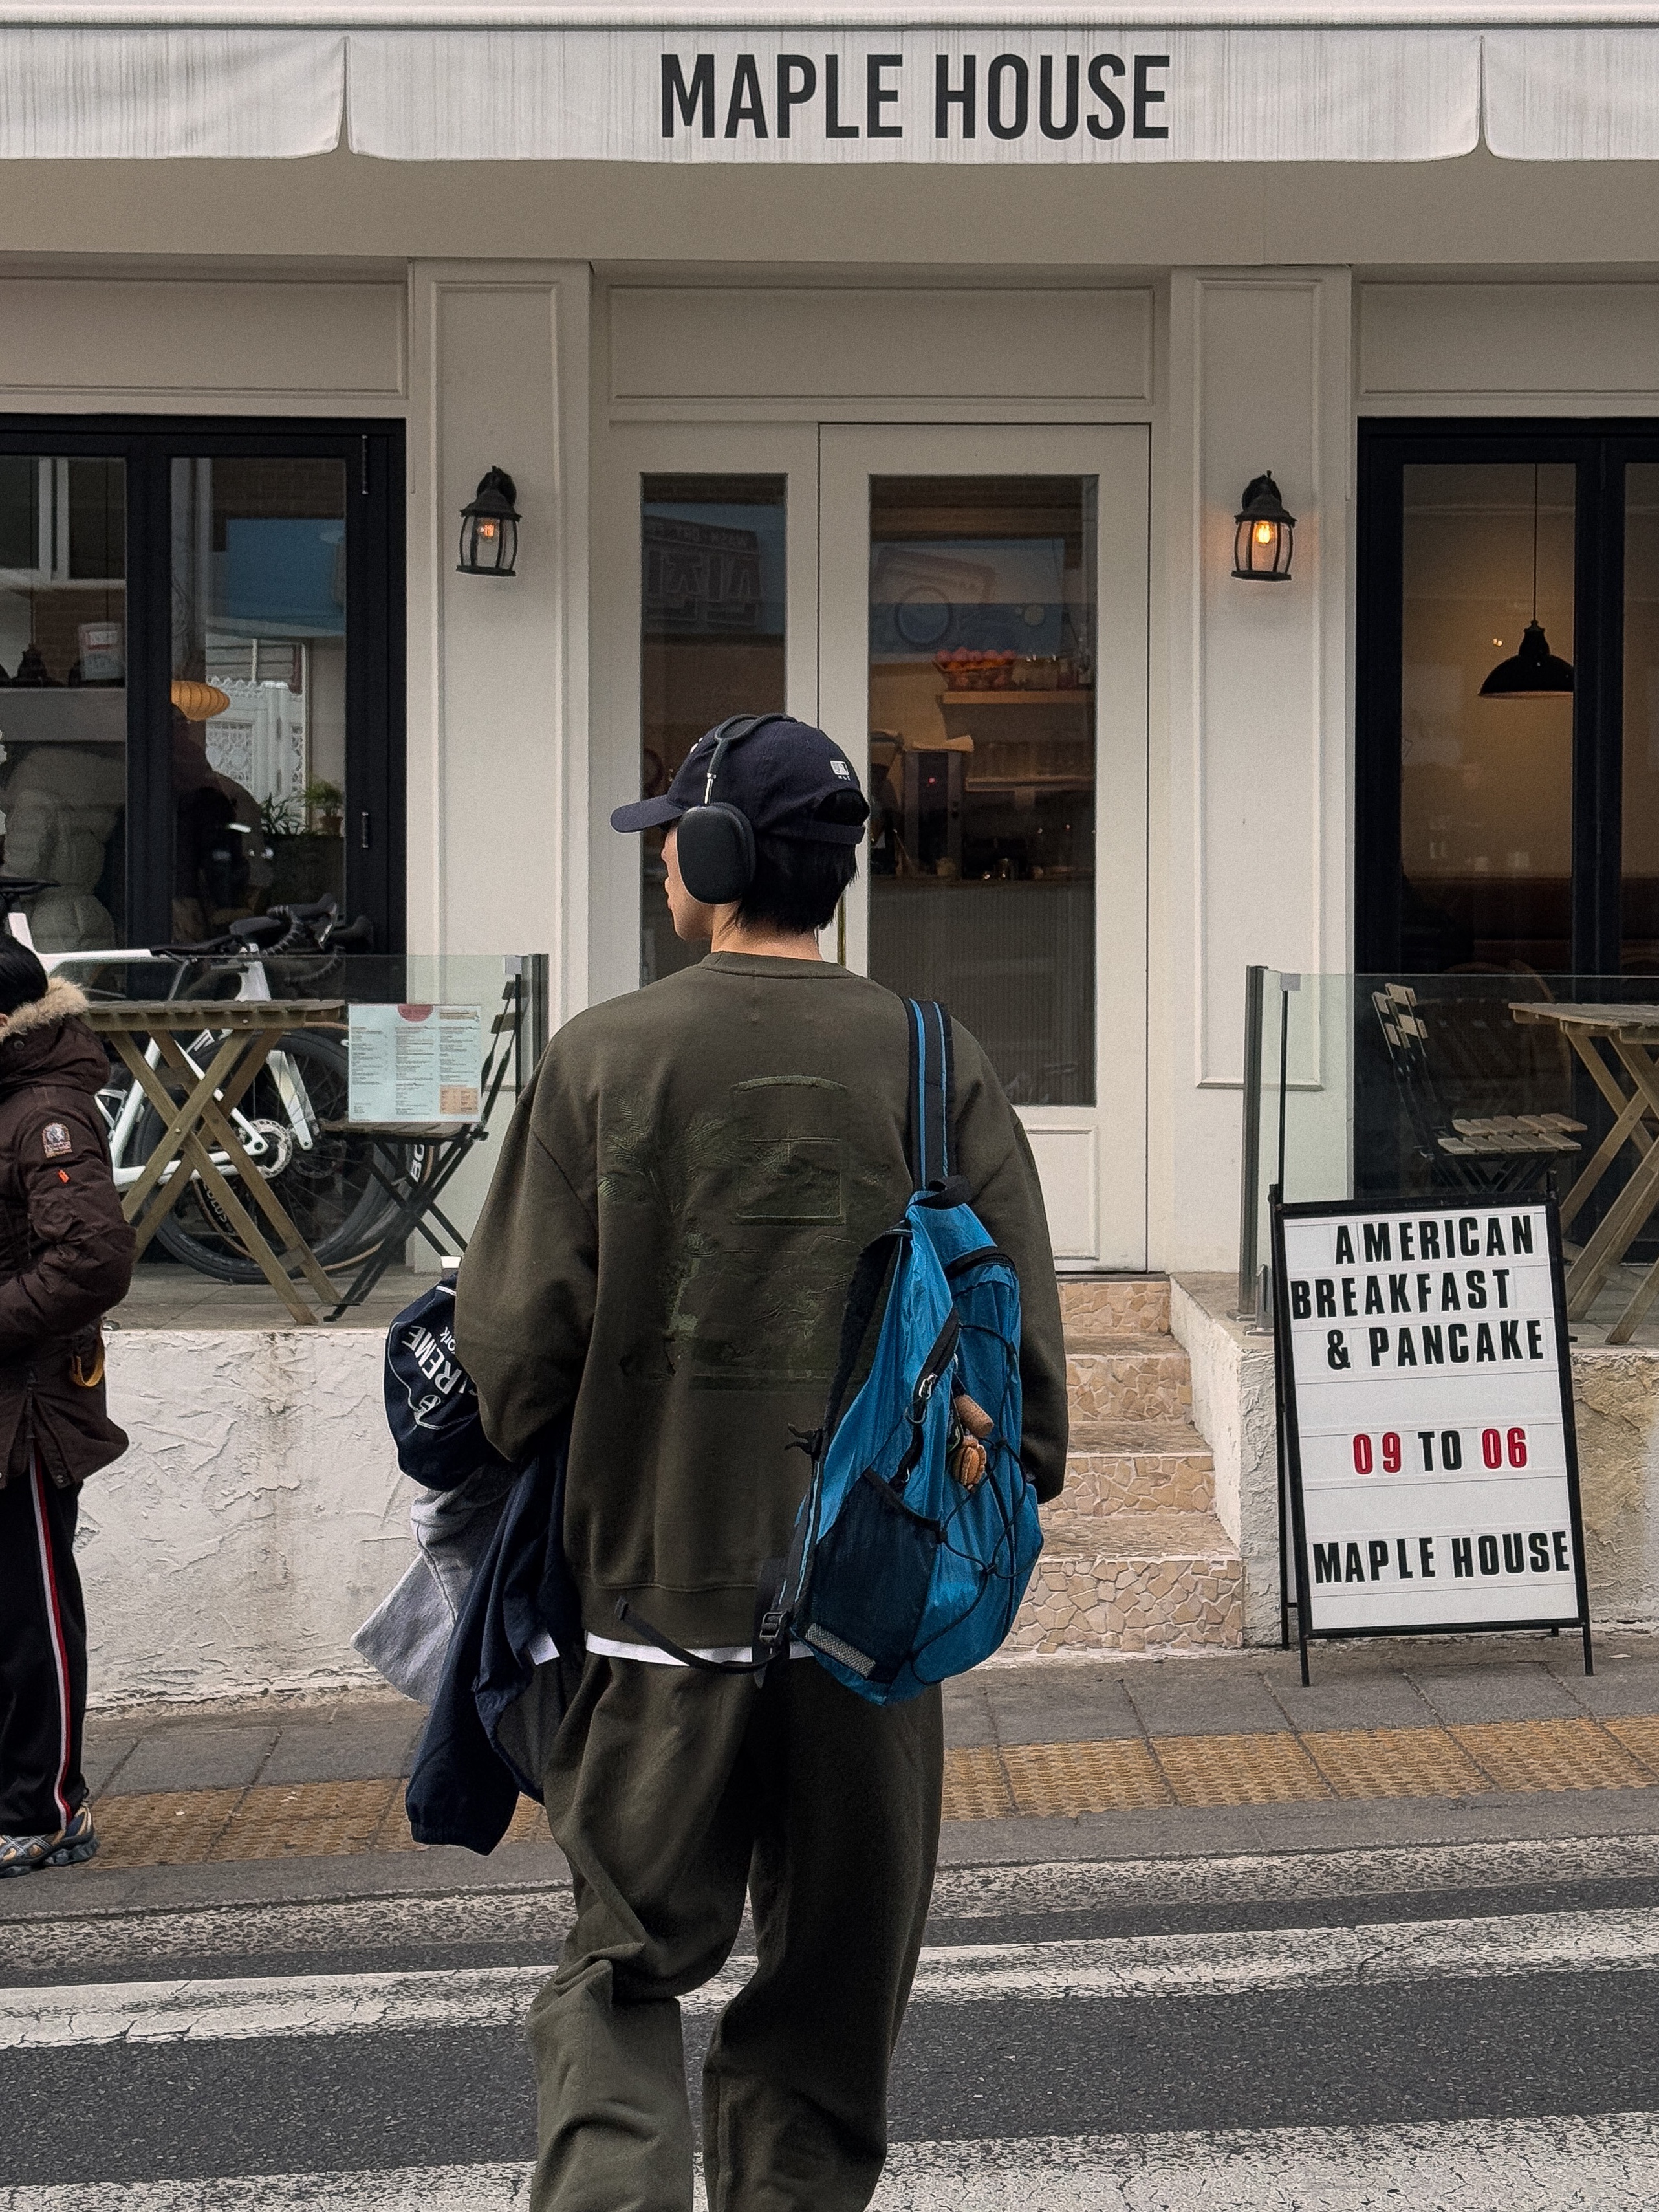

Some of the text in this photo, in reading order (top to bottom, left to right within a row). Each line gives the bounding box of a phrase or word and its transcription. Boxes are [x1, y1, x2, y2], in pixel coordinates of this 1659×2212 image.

[661, 54, 1171, 140] MAPLE HOUSE
[1335, 1214, 1534, 1265] AMERICAN
[1290, 1269, 1510, 1320] BREAKFAST
[439, 1326, 457, 1355] ork
[1327, 1320, 1544, 1370] & PANCAKE
[1353, 1427, 1528, 1475] 09 TO 06
[1312, 1531, 1571, 1584] MAPLE HOUSE
